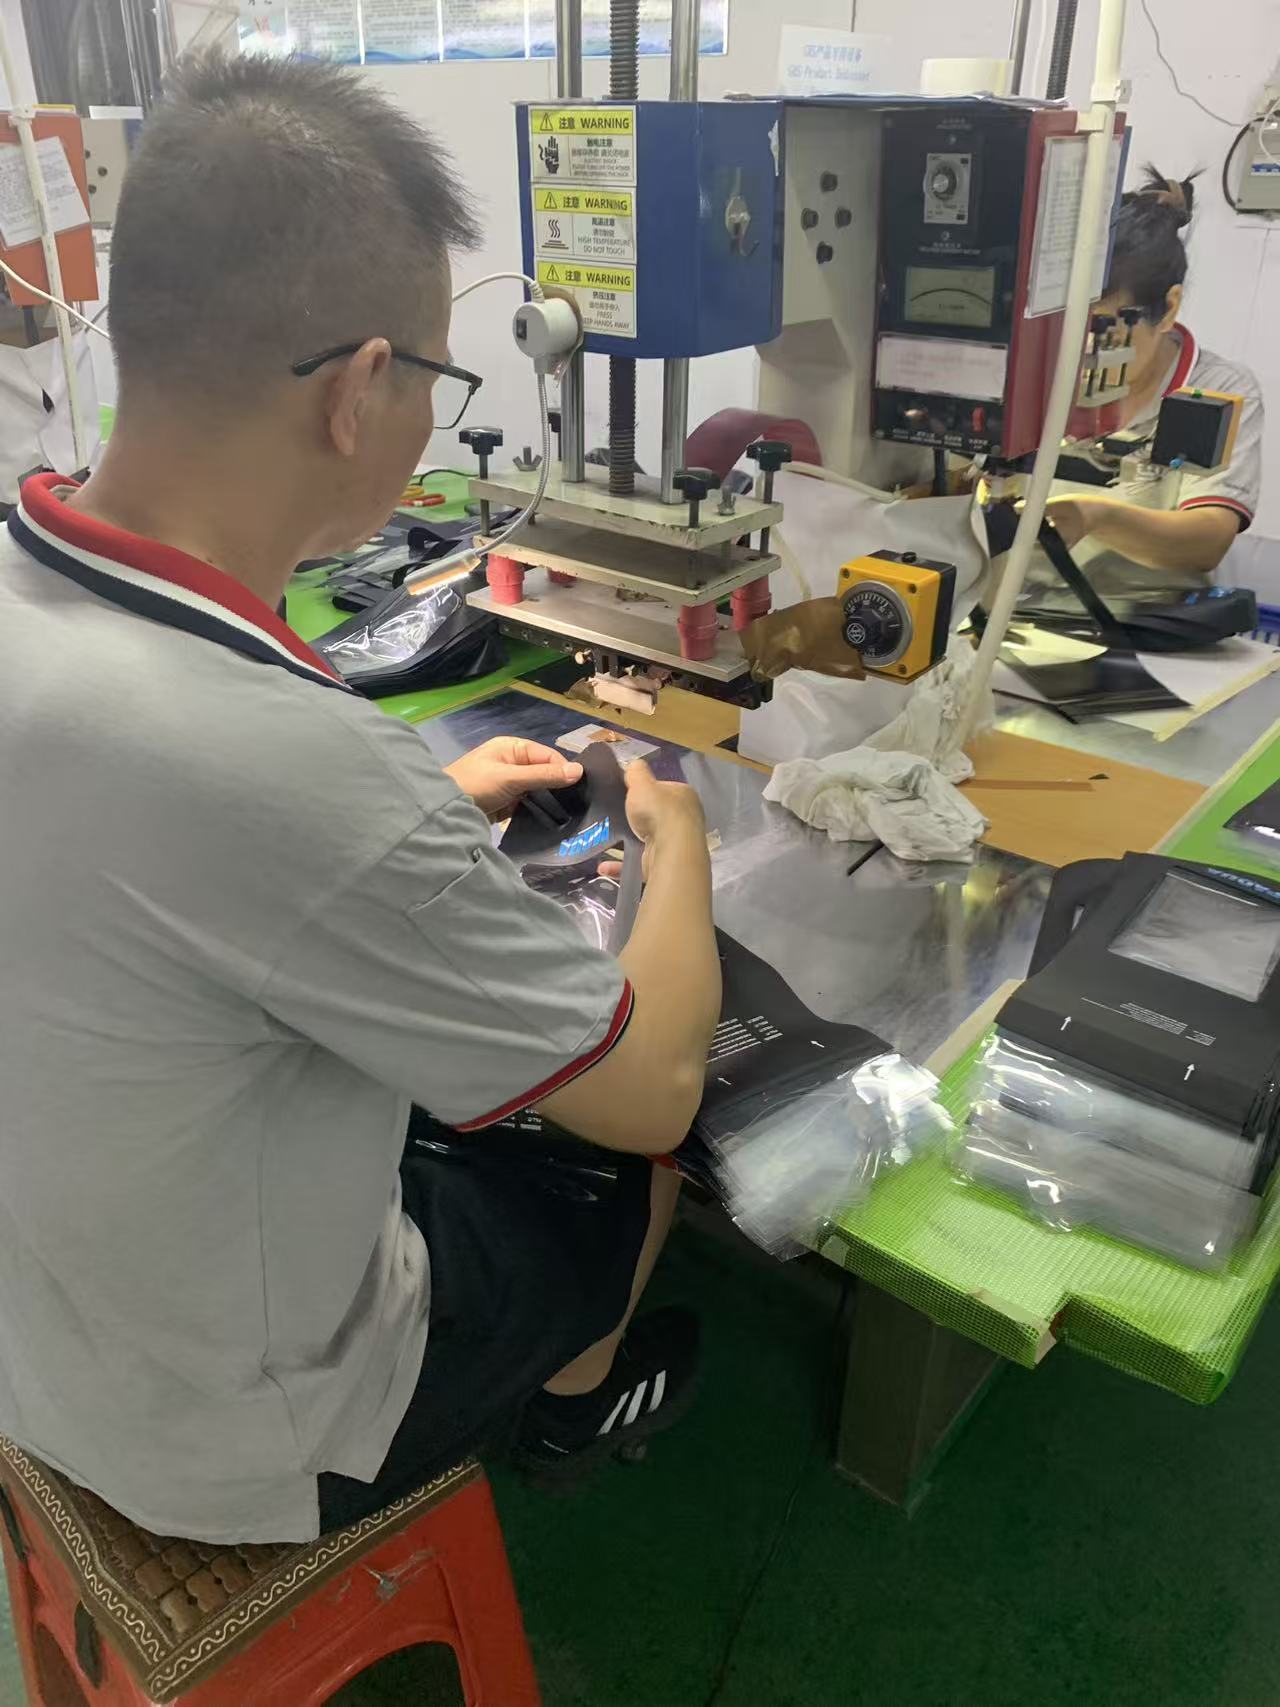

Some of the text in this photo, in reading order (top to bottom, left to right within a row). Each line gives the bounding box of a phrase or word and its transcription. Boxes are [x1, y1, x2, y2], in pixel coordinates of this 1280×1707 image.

[559, 117, 630, 129] 注意 WARNING
[563, 196, 628, 211] 注意 WARNING
[577, 236, 631, 247] HIGH TEMPERATURE
[584, 245, 625, 255] DO NOT TOUCH
[565, 270, 631, 286] 注意 WARNING
[597, 310, 613, 319] PRESS
[594, 318, 613, 328] HANDS
[614, 320, 630, 329] AWAY
